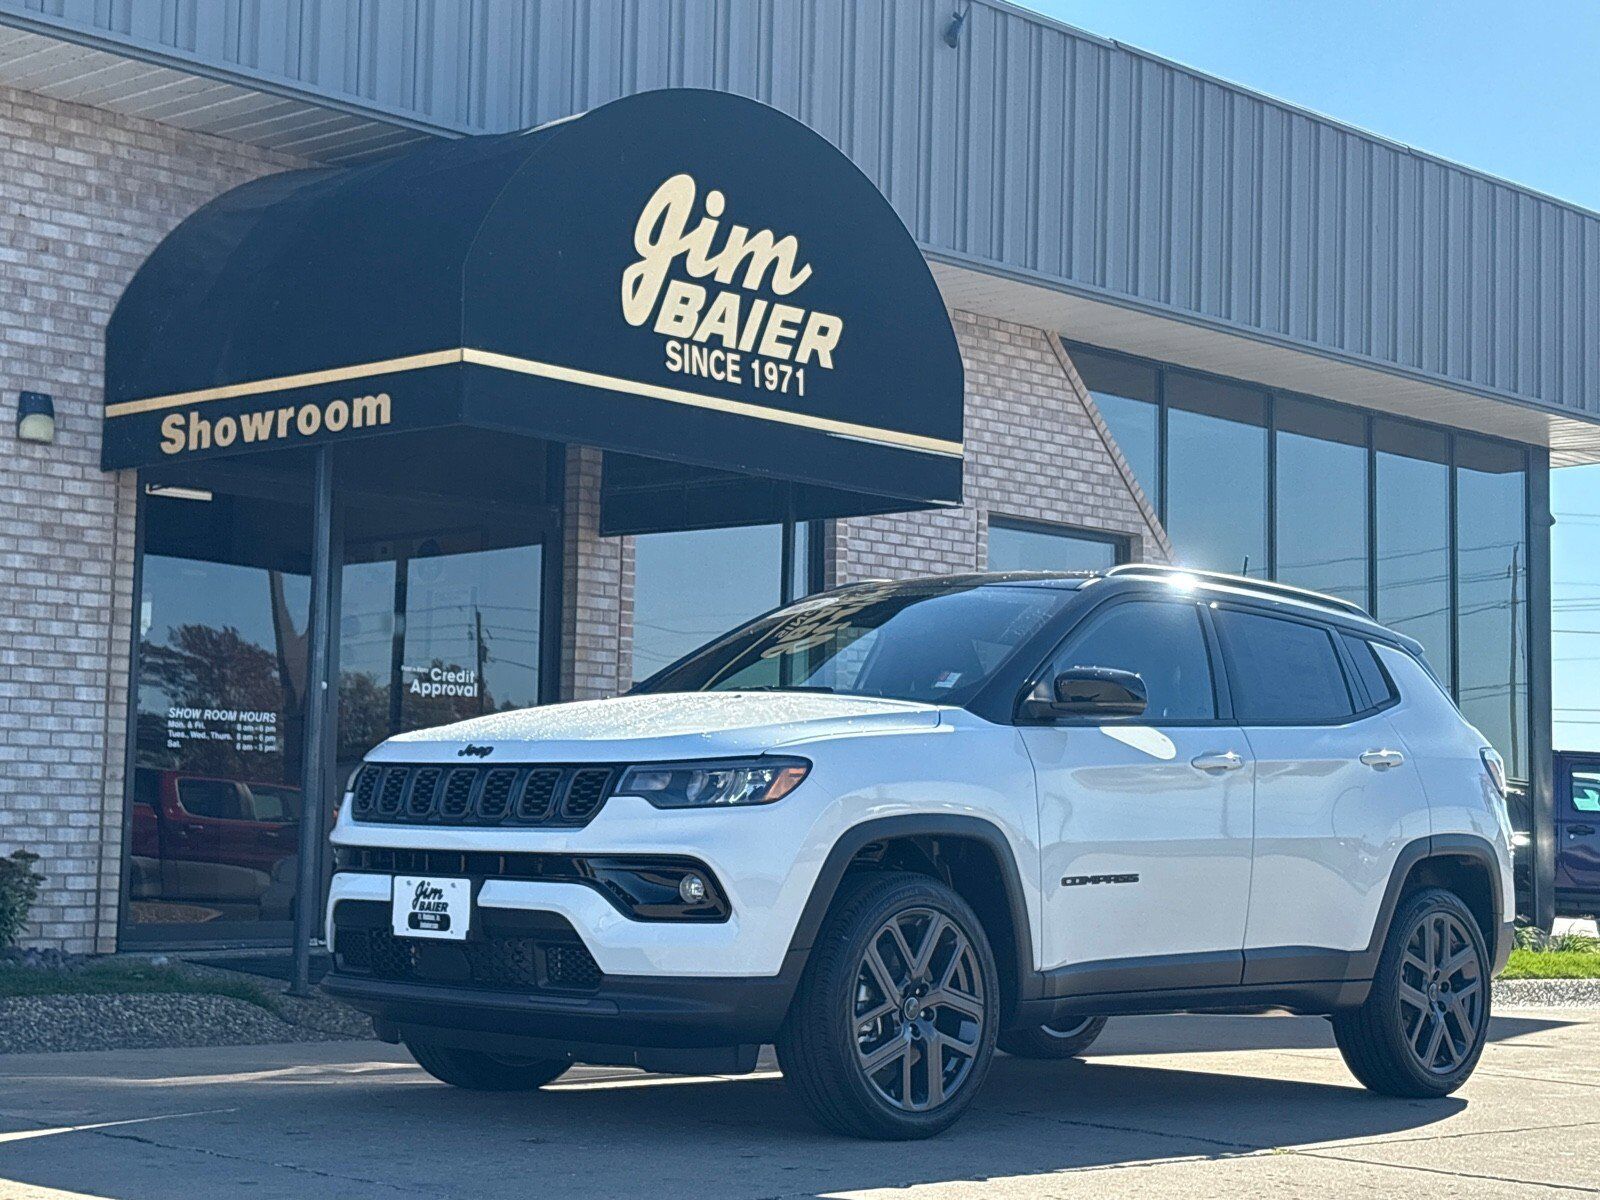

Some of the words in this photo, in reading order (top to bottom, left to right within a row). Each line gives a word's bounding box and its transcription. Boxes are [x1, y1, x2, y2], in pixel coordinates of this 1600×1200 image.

[621, 174, 812, 326] Jim
[654, 279, 842, 369] BAIER
[665, 340, 742, 384] SINCE
[751, 359, 804, 396] 1971
[160, 393, 391, 454] Showroom
[431, 668, 474, 683] Credit
[410, 679, 478, 697] Approval
[169, 708, 202, 719] SHOW
[204, 709, 237, 721] ROOM
[239, 711, 276, 723] HOURS
[458, 744, 494, 758] Jeep
[1061, 874, 1139, 886] COMPASS
[412, 880, 443, 910] Jim
[419, 901, 448, 912] BAIER
